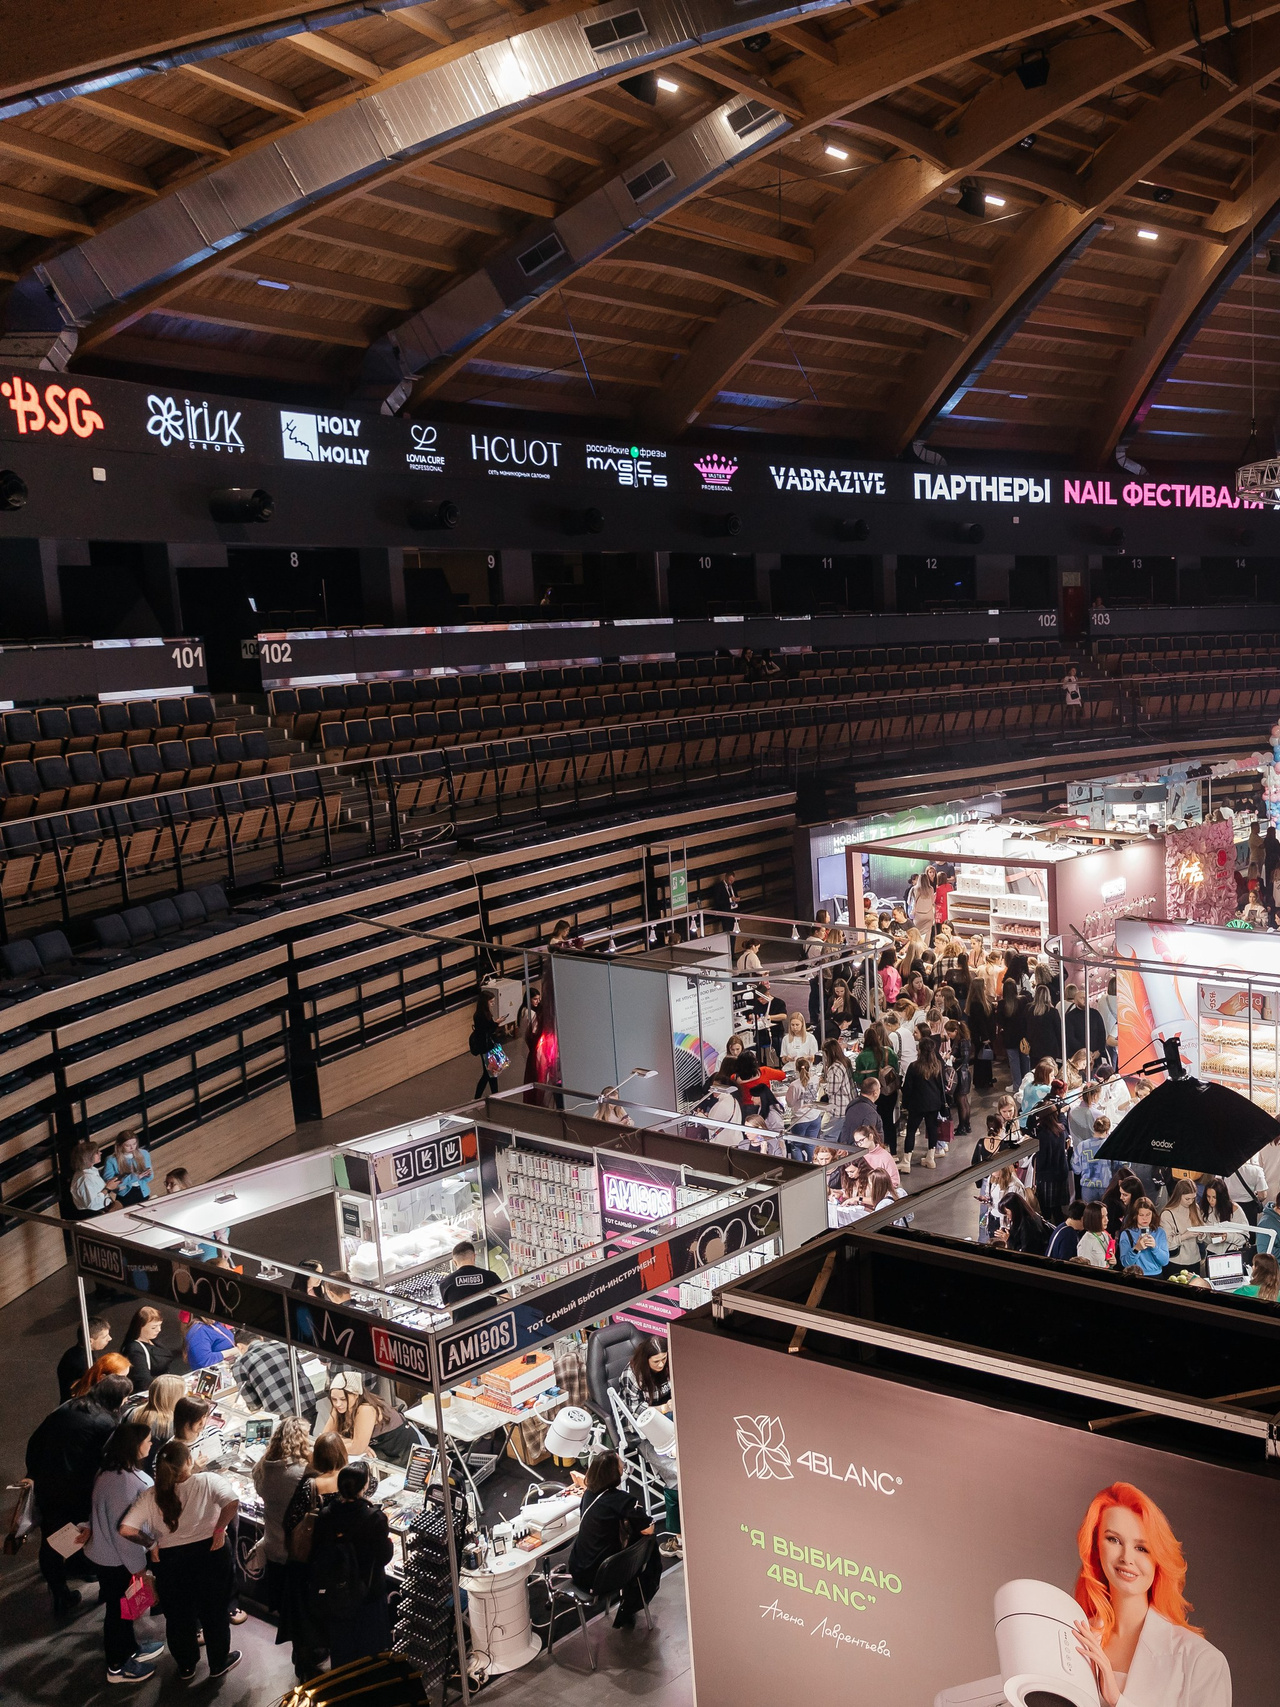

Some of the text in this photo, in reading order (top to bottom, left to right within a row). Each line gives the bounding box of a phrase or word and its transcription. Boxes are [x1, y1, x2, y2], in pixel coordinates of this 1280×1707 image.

[1, 376, 105, 438] BSG
[317, 415, 361, 437] HOLY
[189, 441, 245, 453] GROUP
[586, 443, 667, 458] российские фрезы
[319, 445, 370, 466] MOLLY
[406, 454, 445, 466] LOVIA CURE
[410, 464, 443, 473] PROFESSIONAL
[768, 466, 886, 495] VABRAZIVE
[913, 473, 1050, 503] ПАРТНЕРЫ
[1064, 479, 1117, 505] NAIL
[290, 552, 299, 567] 8
[487, 554, 495, 569] 9
[698, 557, 711, 570] 10
[821, 558, 832, 569] 11
[925, 558, 937, 569] 12
[1131, 559, 1142, 569] 13
[1235, 559, 1246, 569] 14
[1038, 614, 1057, 627] 102
[1091, 613, 1111, 626] 103
[171, 646, 204, 669] 101
[261, 643, 292, 664] 102
[833, 832, 864, 847] НОВЫЕ
[82, 1242, 120, 1275] AMIGOS
[137, 1263, 159, 1272] САМЫЙ
[457, 1275, 482, 1286] AMIGOS
[526, 1255, 657, 1334] ТОТ САМЫЙ БЬЮТИ-ИНСТРУМЕНТ
[448, 1321, 510, 1371] AMIGOS
[378, 1333, 426, 1375] AMIGOS
[774, 1537, 902, 1594] ВЫБИРАЮ
[759, 1599, 892, 1658] Алена Лаврентьева
